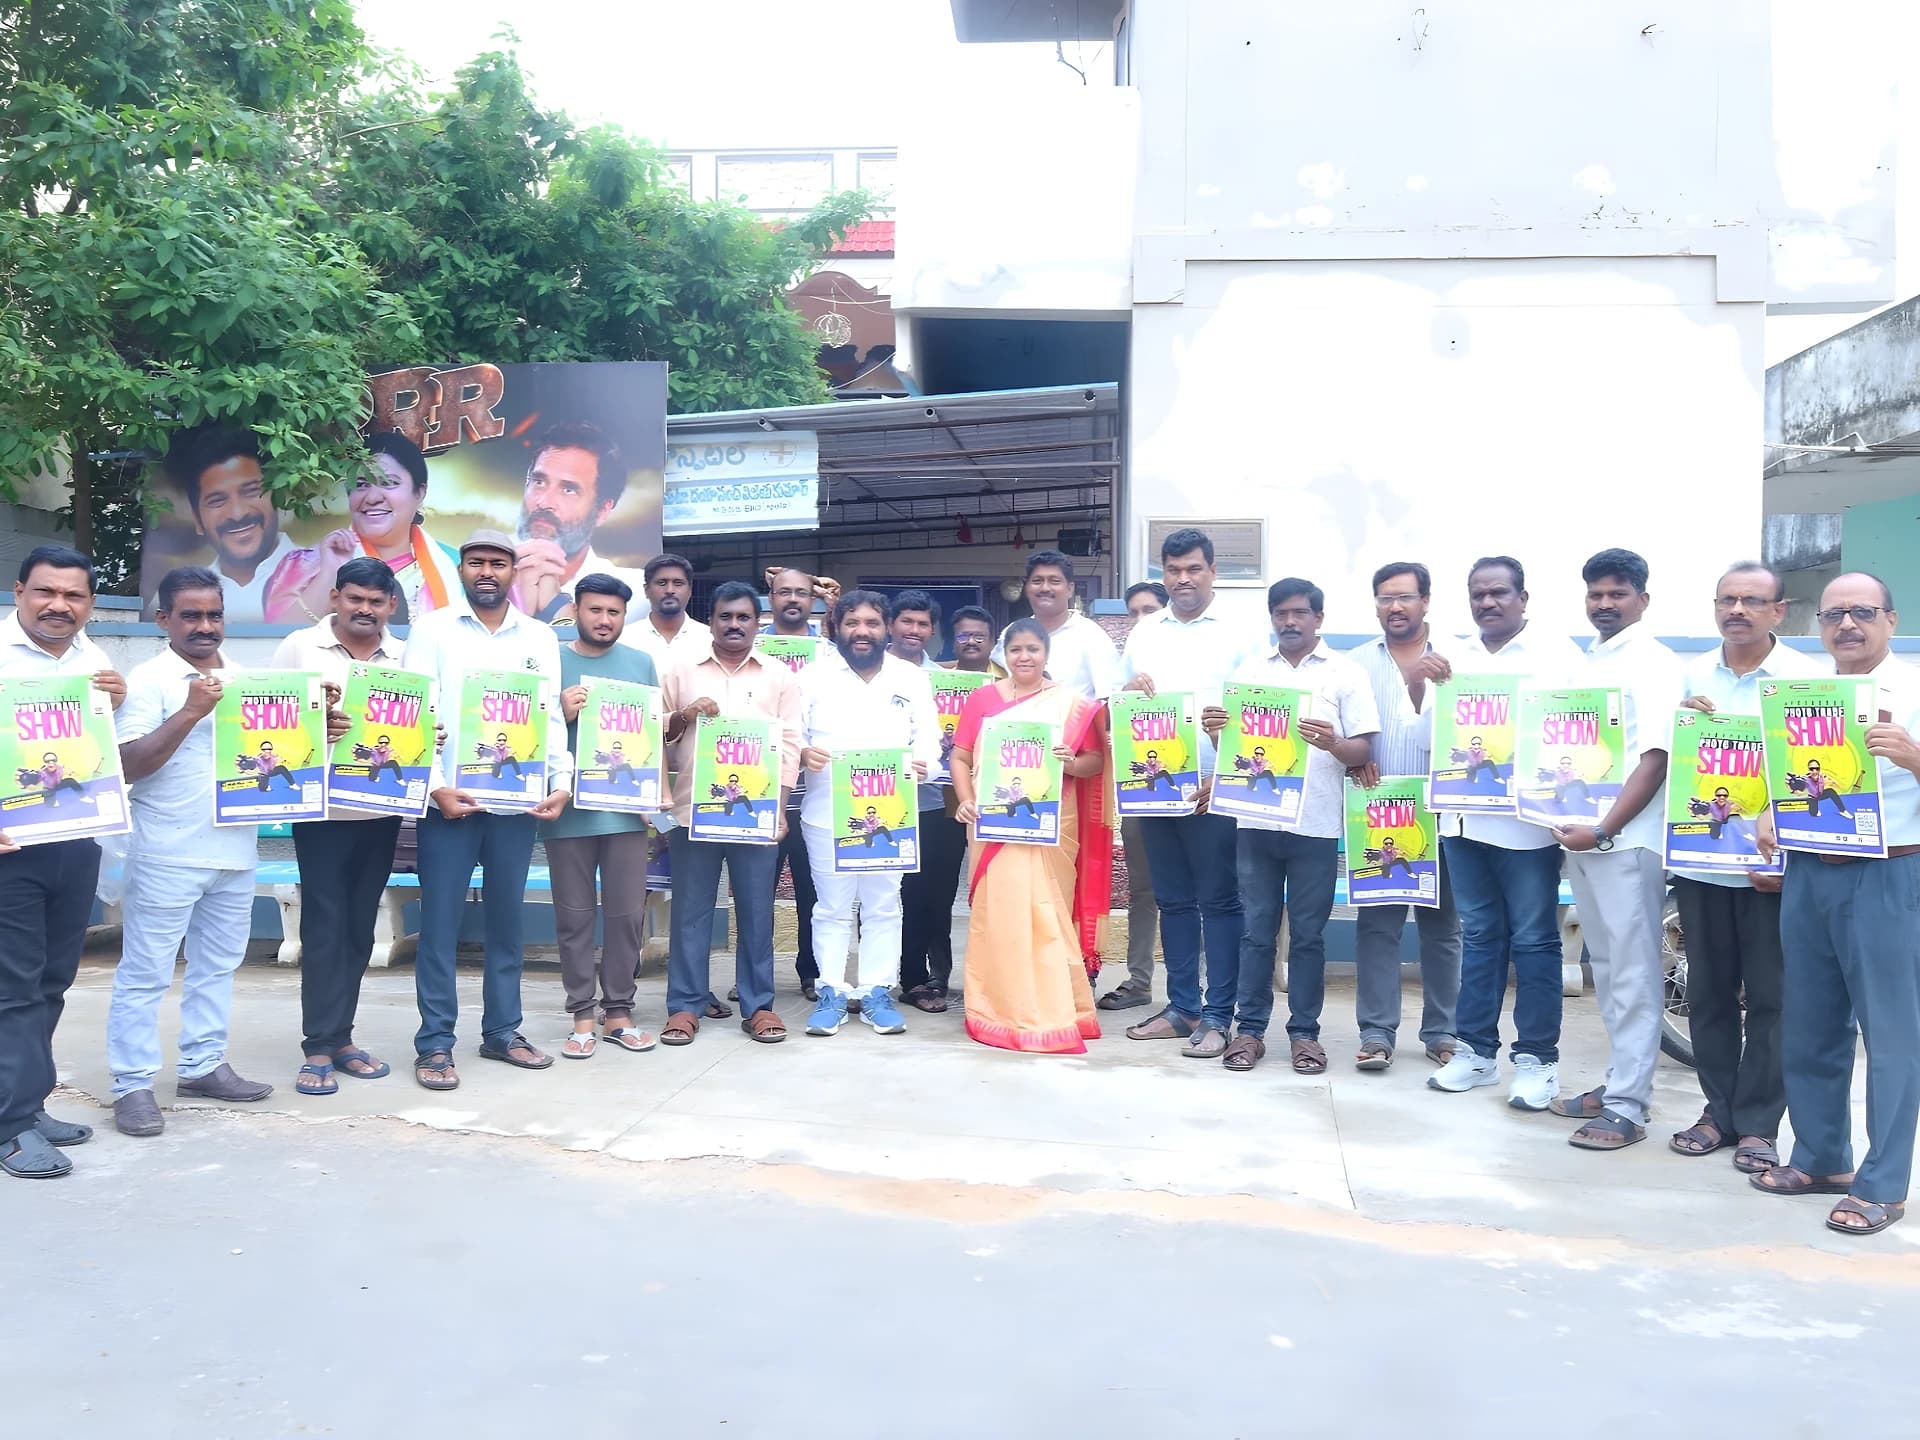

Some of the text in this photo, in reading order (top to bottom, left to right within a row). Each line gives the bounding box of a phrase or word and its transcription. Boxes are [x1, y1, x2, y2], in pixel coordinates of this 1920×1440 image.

[241, 703, 300, 730] SHOW
[365, 697, 421, 728] SHOW
[482, 695, 531, 725] SHOW
[933, 695, 967, 715] SHO
[1456, 696, 1510, 726] SHOW
[1784, 707, 1845, 717] PHOTO TRADE
[15, 709, 82, 741] SHOW
[600, 705, 644, 734] SHOW
[1131, 718, 1176, 740] SHOW
[1240, 713, 1290, 740] SHOW
[1543, 720, 1599, 745] SHOW
[1785, 716, 1845, 746] SHOW
[716, 742, 762, 766] SHOW
[1000, 746, 1044, 768] SHOW
[1699, 738, 1763, 751] PHOTO TRADE
[1697, 748, 1762, 778] SHOW
[851, 775, 896, 797] SHOW
[1367, 806, 1416, 828] SHOW
